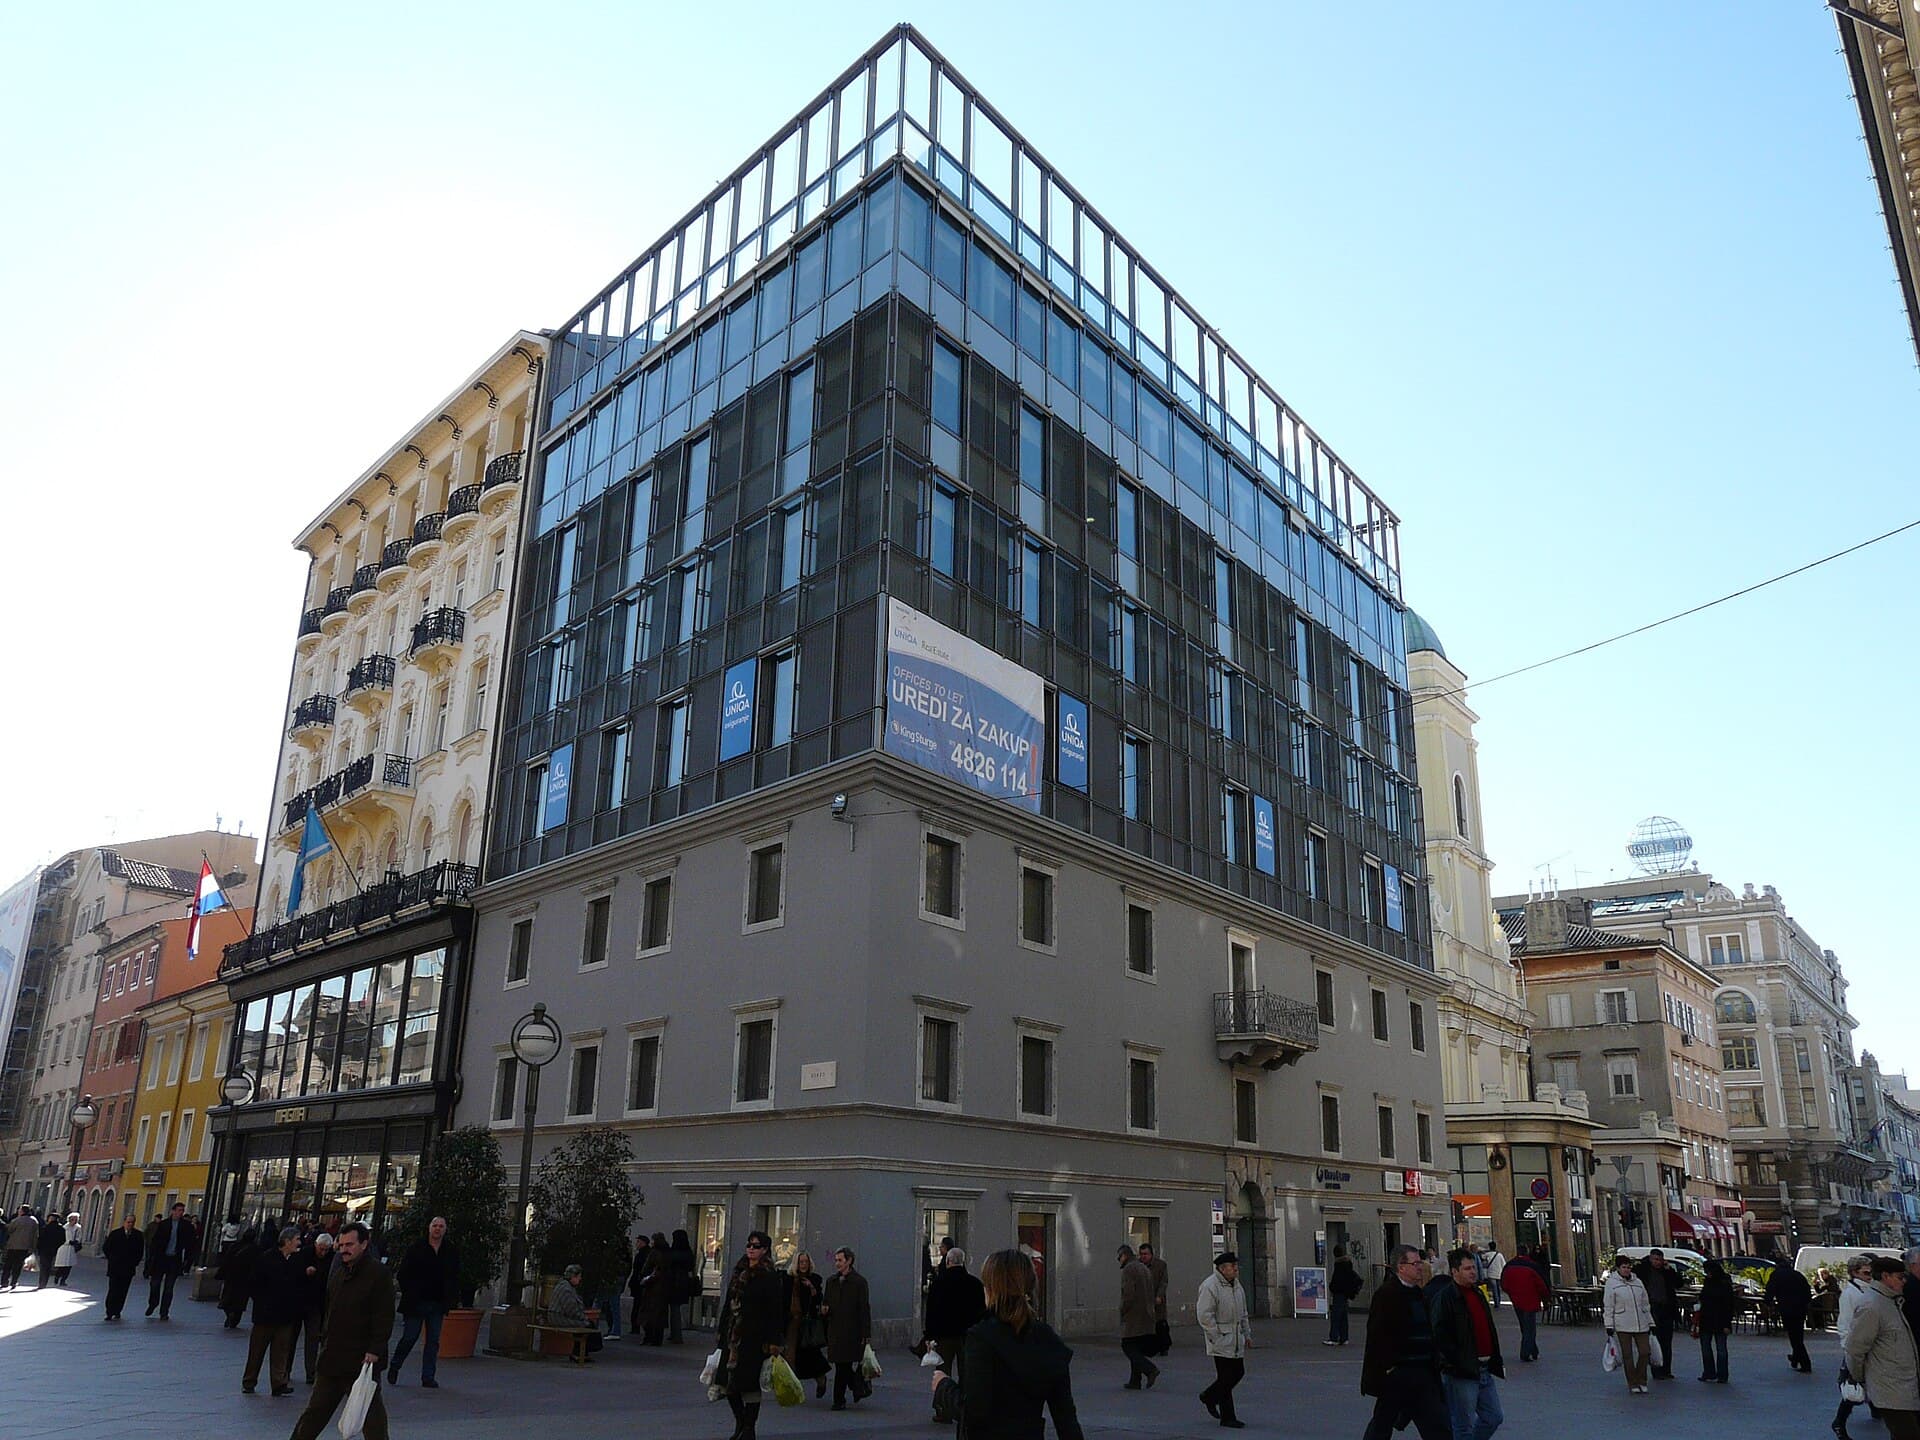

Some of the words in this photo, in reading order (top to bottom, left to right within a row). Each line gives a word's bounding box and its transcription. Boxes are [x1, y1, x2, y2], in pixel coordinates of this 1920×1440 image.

[894, 627, 918, 646] UNIQA
[893, 665, 932, 691] OFFICES
[934, 682, 946, 697] TO
[947, 689, 965, 706] LET
[725, 699, 750, 718] UNIQA
[892, 679, 947, 722] UREDI
[951, 706, 974, 735] ZA
[1061, 730, 1085, 751] UNIQA
[951, 743, 995, 782] 4826
[1001, 763, 1028, 796] 114
